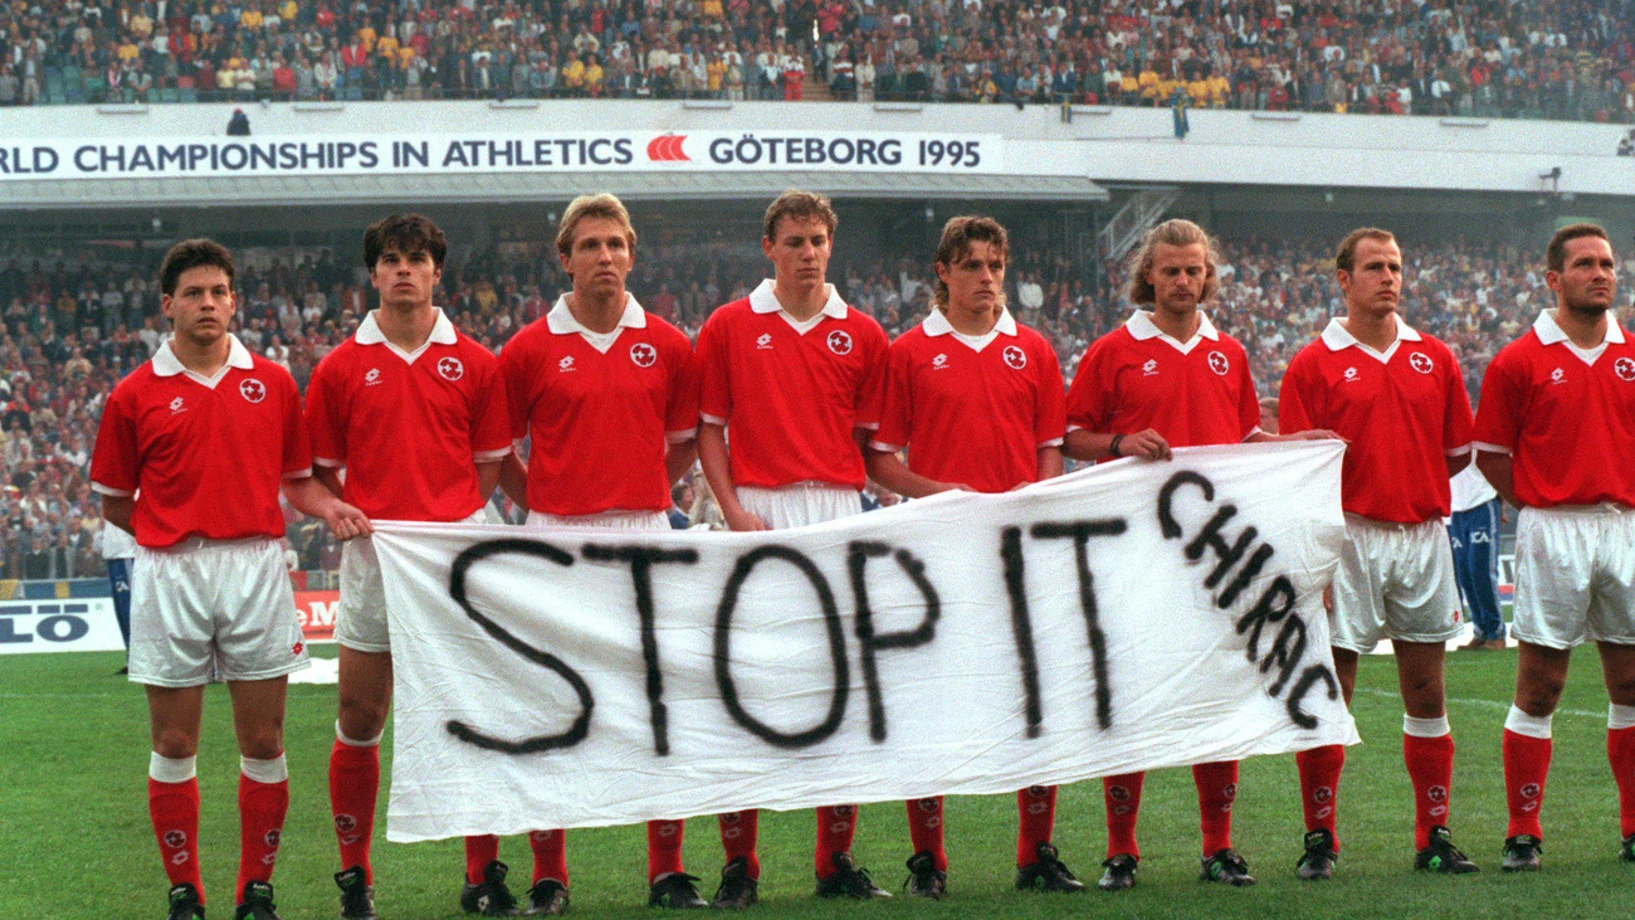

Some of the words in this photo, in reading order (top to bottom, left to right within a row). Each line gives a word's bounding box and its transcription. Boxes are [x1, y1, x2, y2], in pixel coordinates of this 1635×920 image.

[74, 142, 378, 172] CHAMPIONSHIPS
[393, 141, 429, 167] IN
[442, 137, 633, 167] ATHLETICS
[708, 134, 902, 165] GÖTEBORG
[919, 139, 981, 167] 1995
[446, 538, 942, 757] STOP
[1000, 517, 1128, 740] IT
[1156, 470, 1338, 730] CHIRAC
